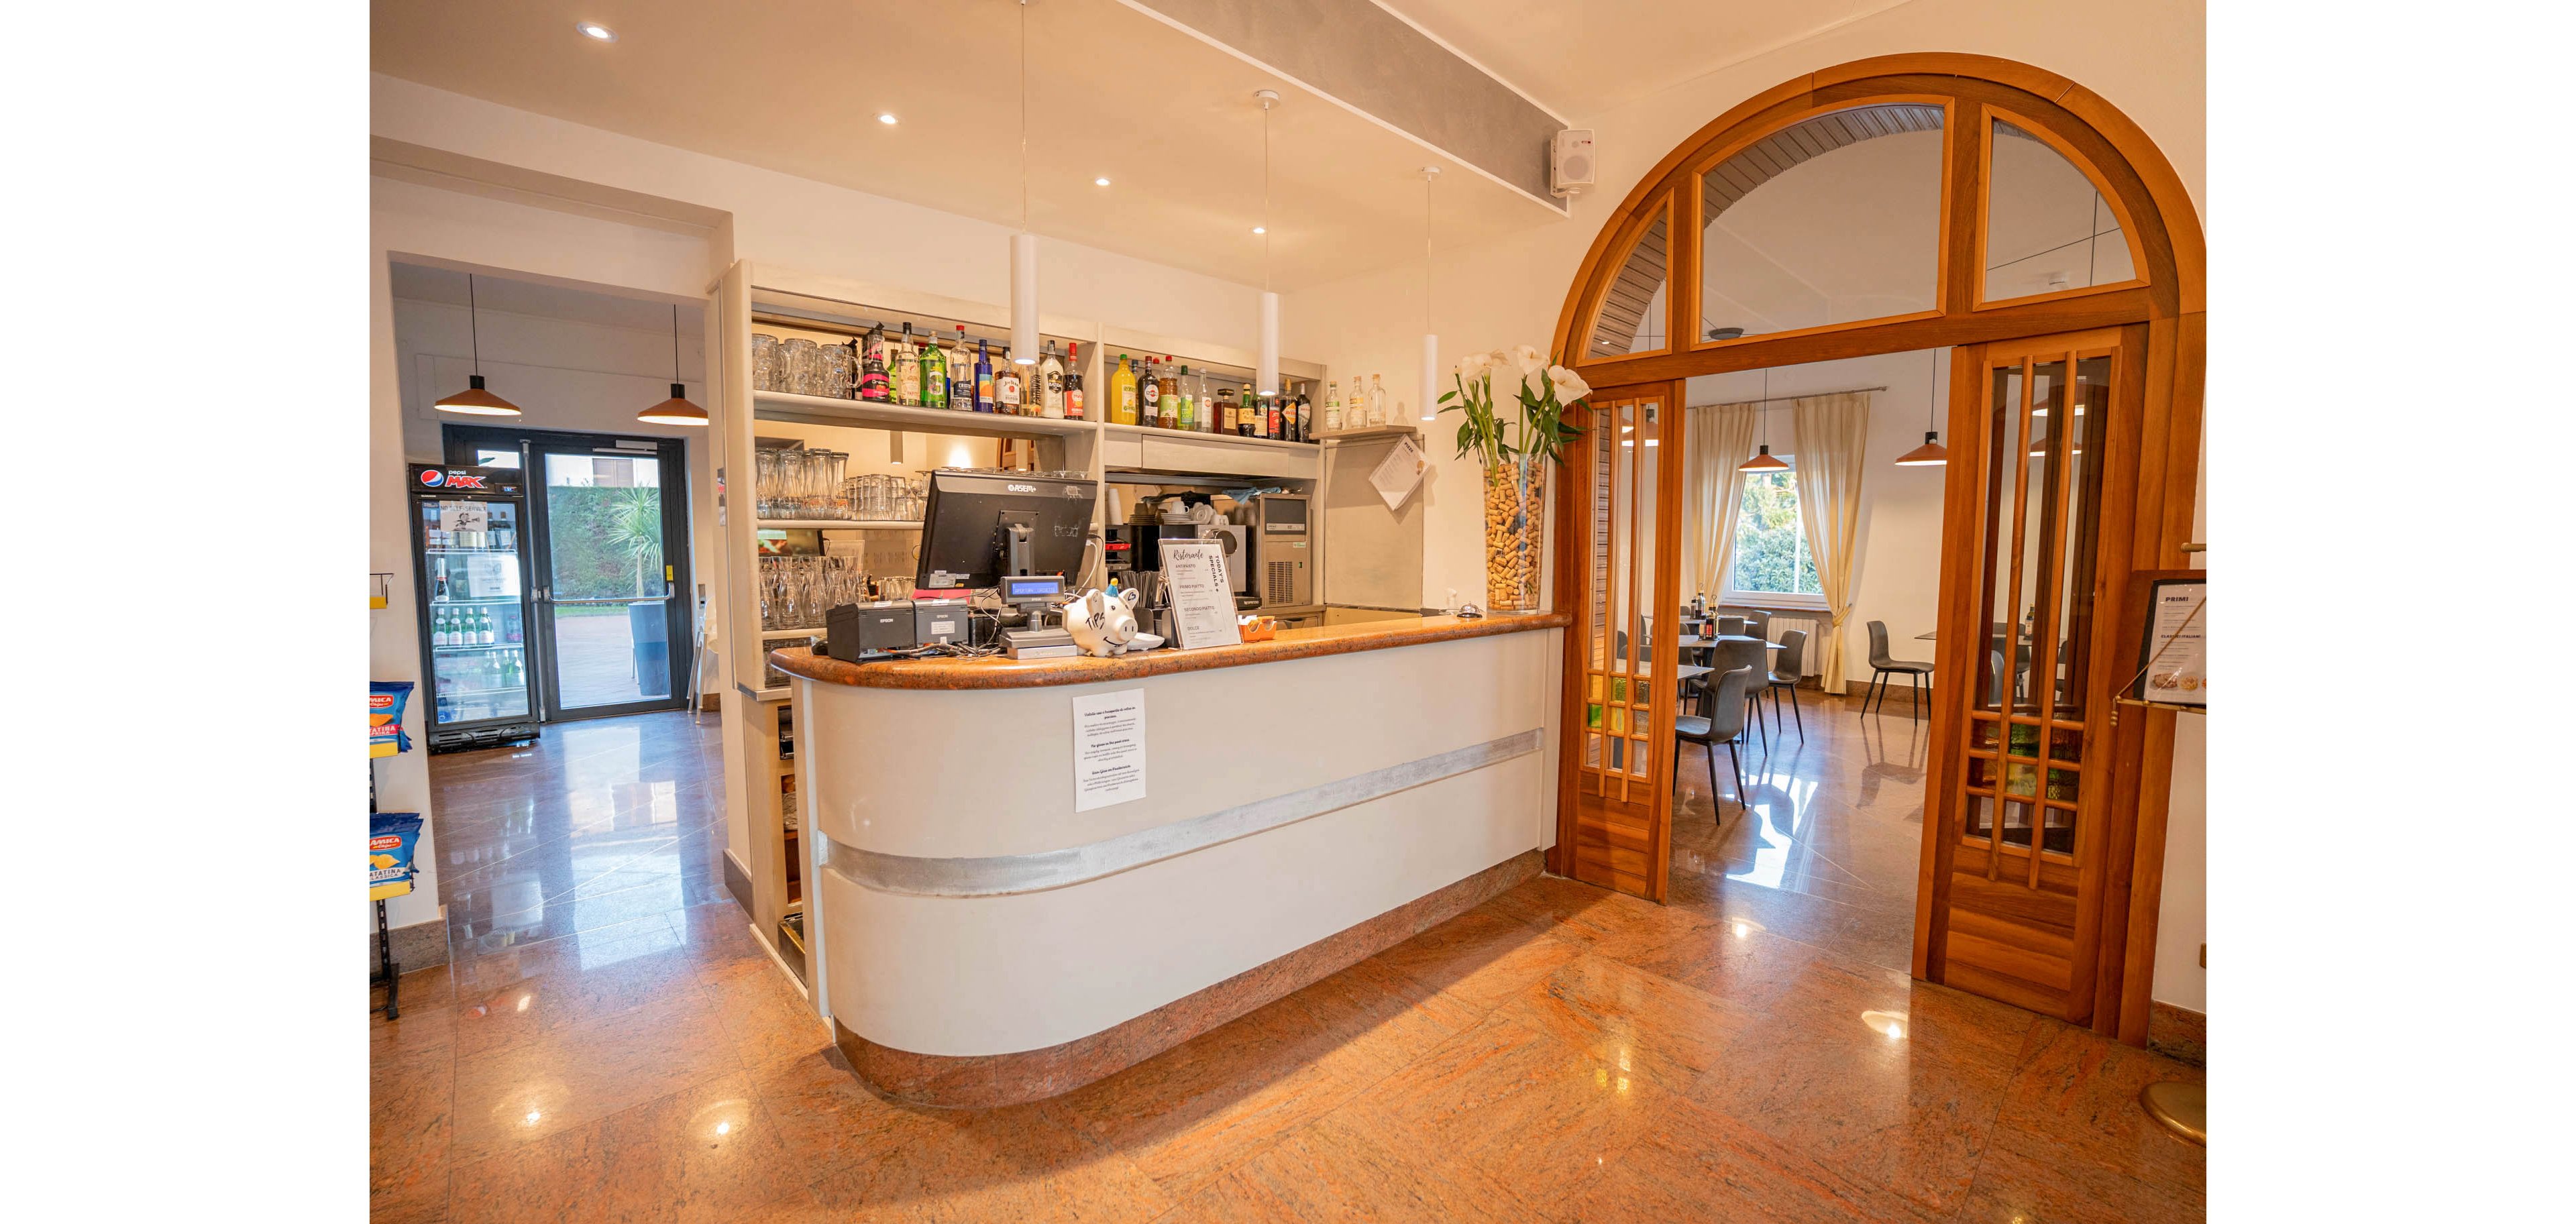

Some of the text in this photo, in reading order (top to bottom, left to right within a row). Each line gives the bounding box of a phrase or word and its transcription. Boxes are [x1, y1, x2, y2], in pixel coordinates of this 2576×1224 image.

[445, 476, 487, 489] MAX
[1173, 549, 1203, 561] Ristorante
[1209, 555, 1219, 587] SPECIALS
[1215, 555, 1224, 583] TODAY'S
[1085, 612, 1106, 630] TIPS
[370, 838, 400, 846] AMICA
[370, 869, 401, 877] ATATINA
